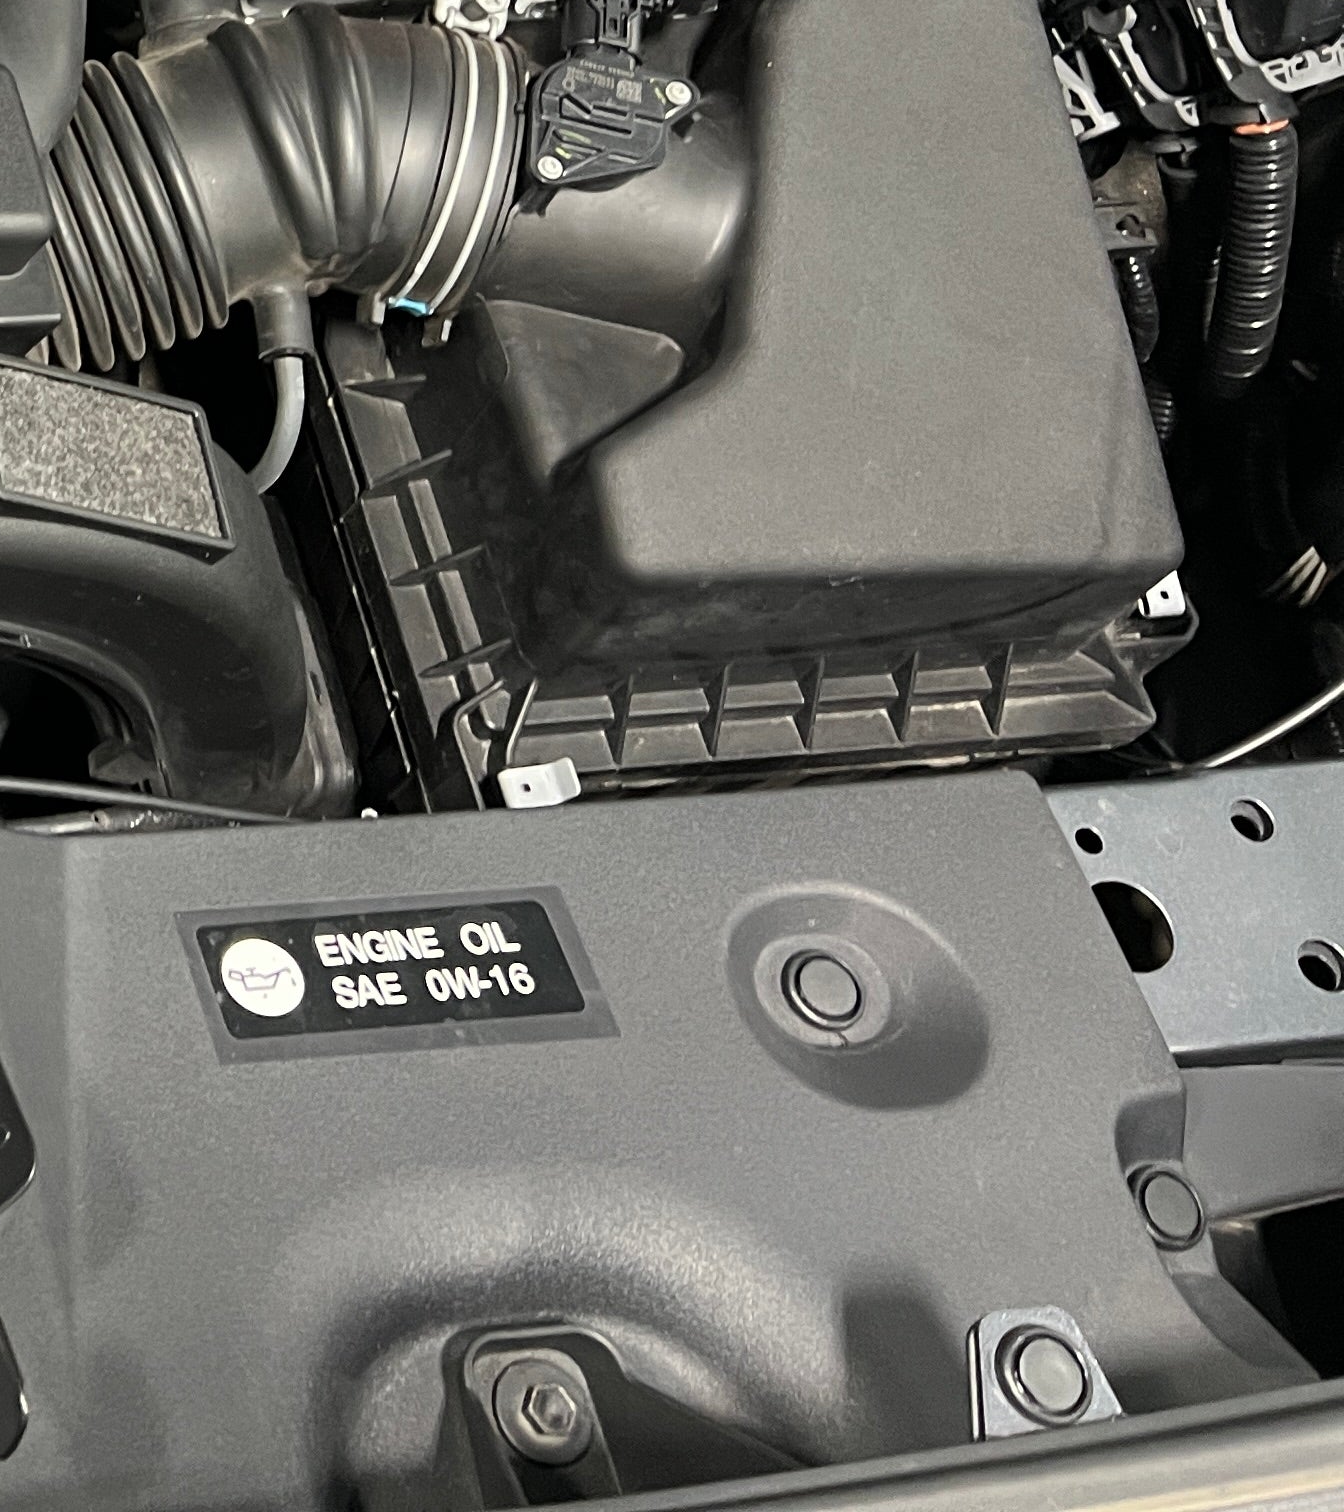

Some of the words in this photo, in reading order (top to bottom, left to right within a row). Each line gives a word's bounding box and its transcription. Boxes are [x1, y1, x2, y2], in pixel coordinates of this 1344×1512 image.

[315, 926, 445, 967] ENGINE
[460, 921, 522, 956] OIL
[331, 971, 408, 1009] SAE
[425, 962, 535, 1002] 0W-16
